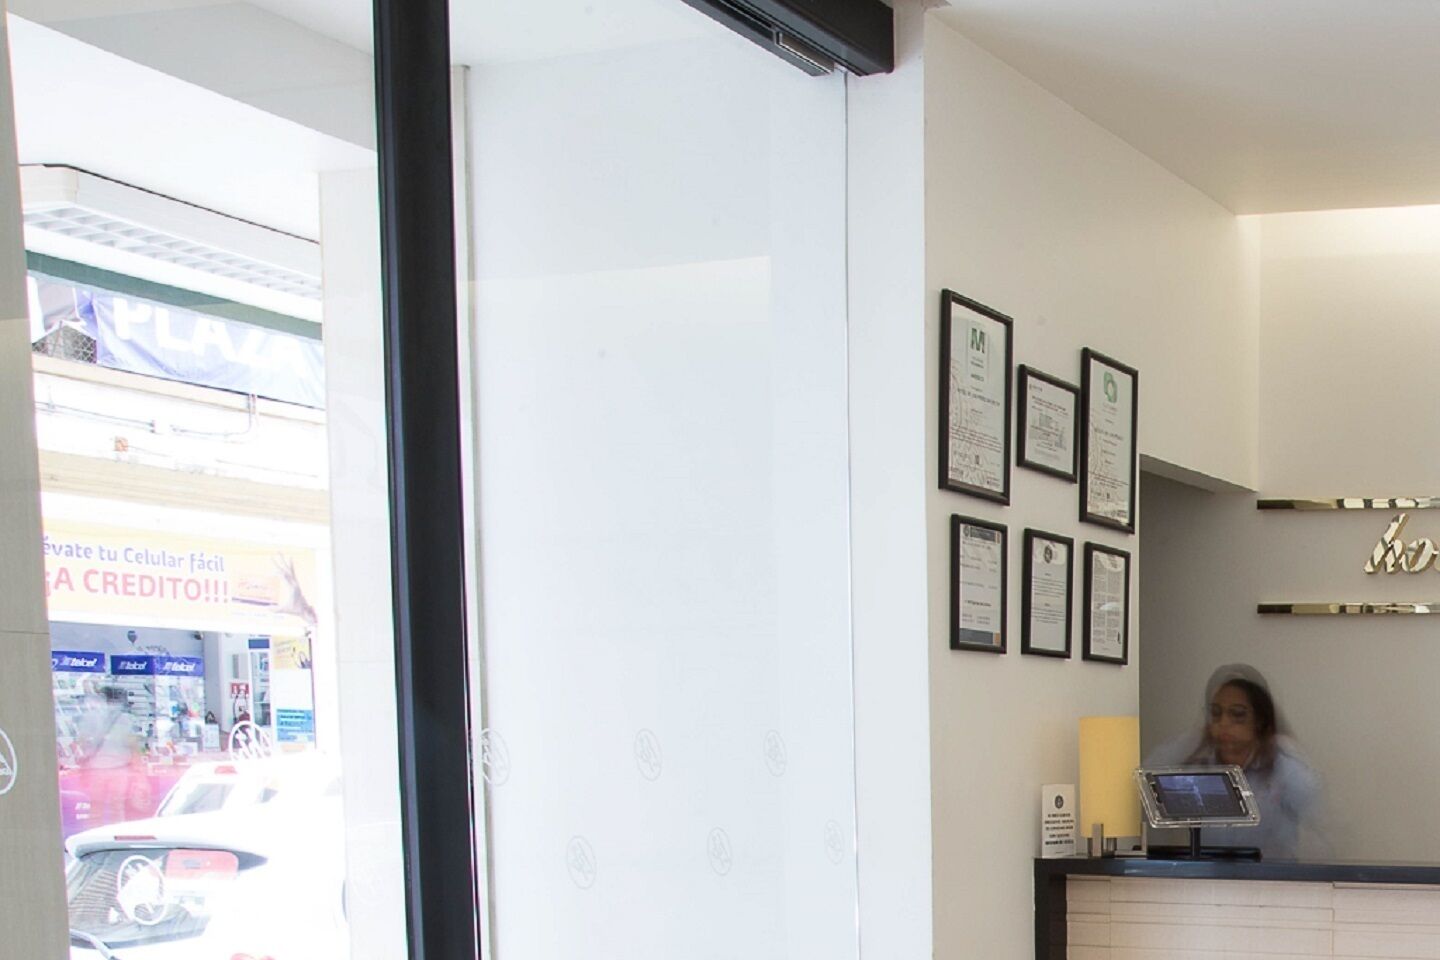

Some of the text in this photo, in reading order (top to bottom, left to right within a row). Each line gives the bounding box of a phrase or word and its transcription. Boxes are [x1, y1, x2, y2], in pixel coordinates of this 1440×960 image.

[112, 296, 310, 374] PLAZA
[99, 545, 118, 562] tu
[123, 547, 185, 569] Celular
[189, 552, 225, 573] fácil
[83, 568, 229, 604] CREDITO!!!
